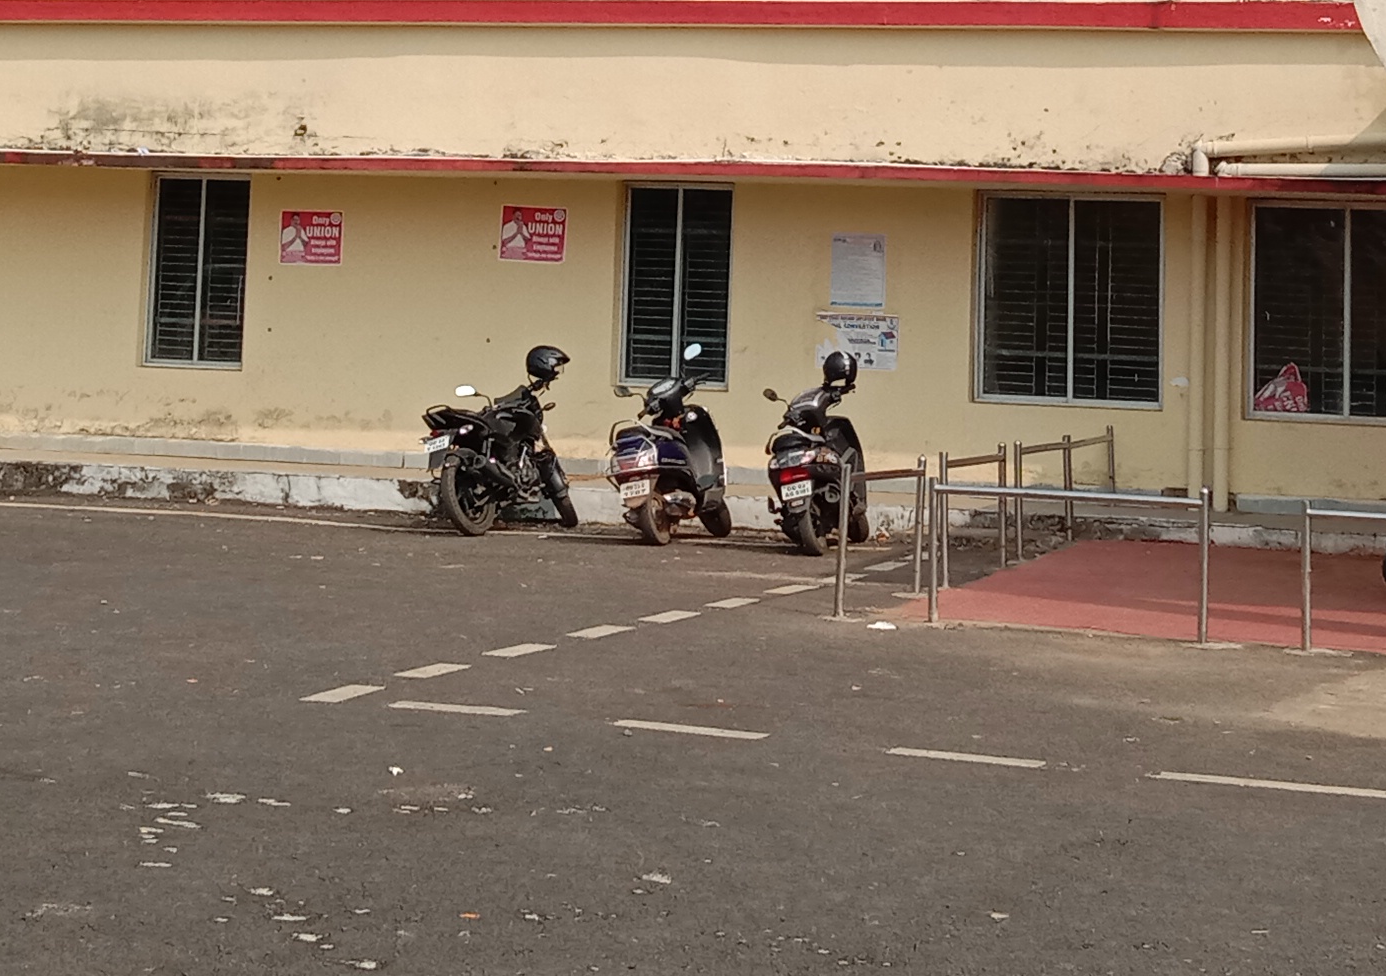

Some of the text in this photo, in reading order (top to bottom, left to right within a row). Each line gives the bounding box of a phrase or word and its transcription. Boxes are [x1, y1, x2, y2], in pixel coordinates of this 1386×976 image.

[312, 214, 330, 227] Only
[535, 211, 554, 224] Only
[306, 225, 341, 239] UNION
[527, 222, 564, 236] UNION
